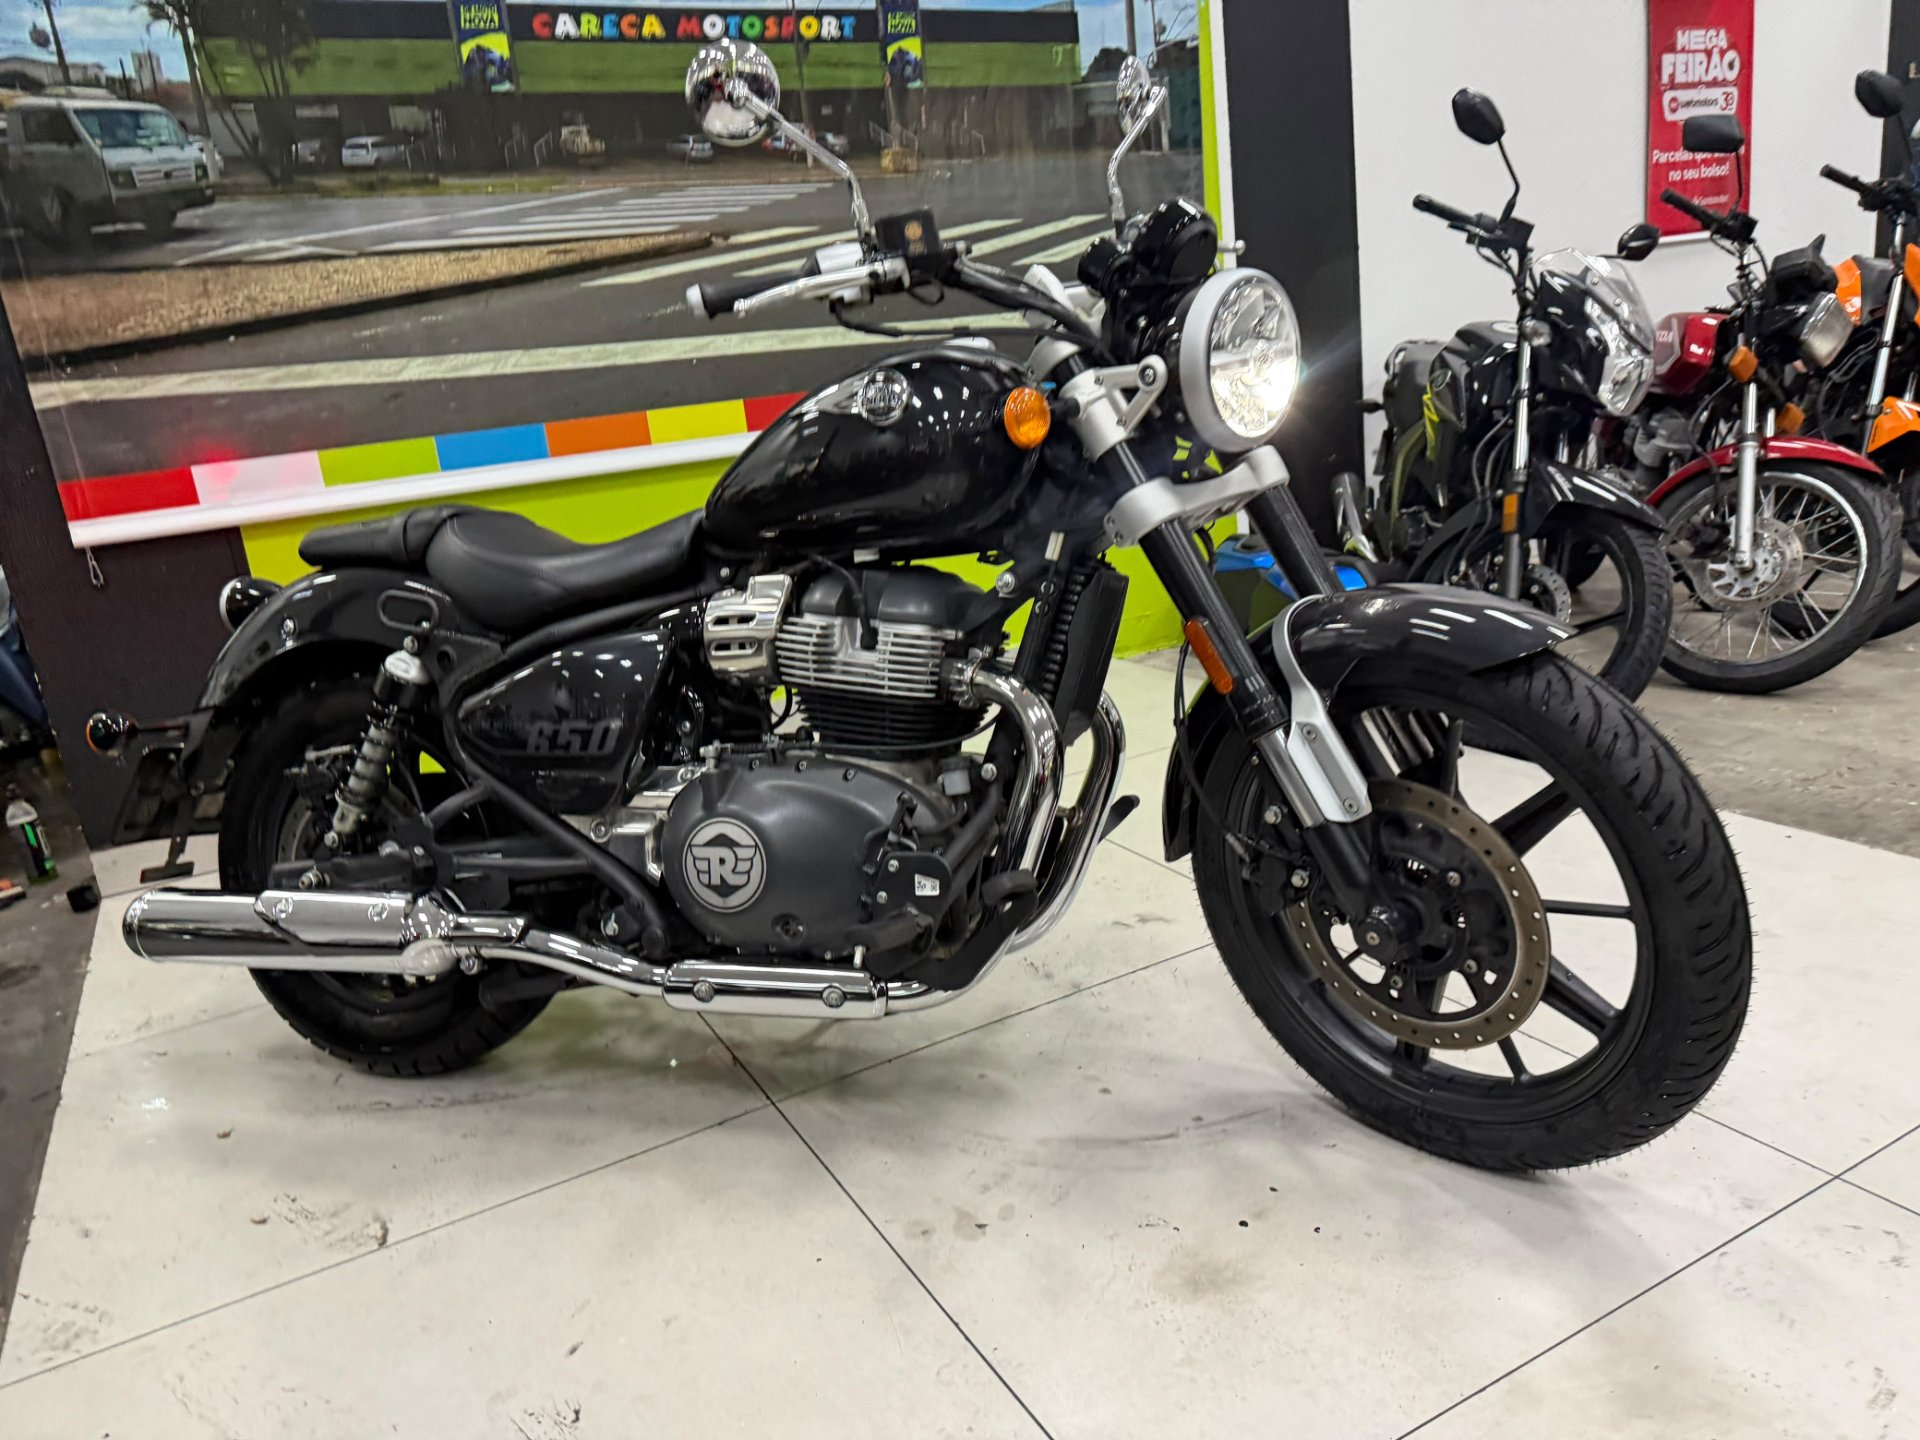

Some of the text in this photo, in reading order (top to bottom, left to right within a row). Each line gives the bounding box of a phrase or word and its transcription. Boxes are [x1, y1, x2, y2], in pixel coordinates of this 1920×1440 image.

[532, 13, 857, 40] CARECA MOTOSPORT
[1676, 28, 1728, 50] MEGA
[1661, 48, 1740, 84] FEIRÃO
[1652, 147, 1693, 164] Parcelas
[1669, 161, 1730, 182] no seu bolso!
[526, 718, 624, 755] 650
